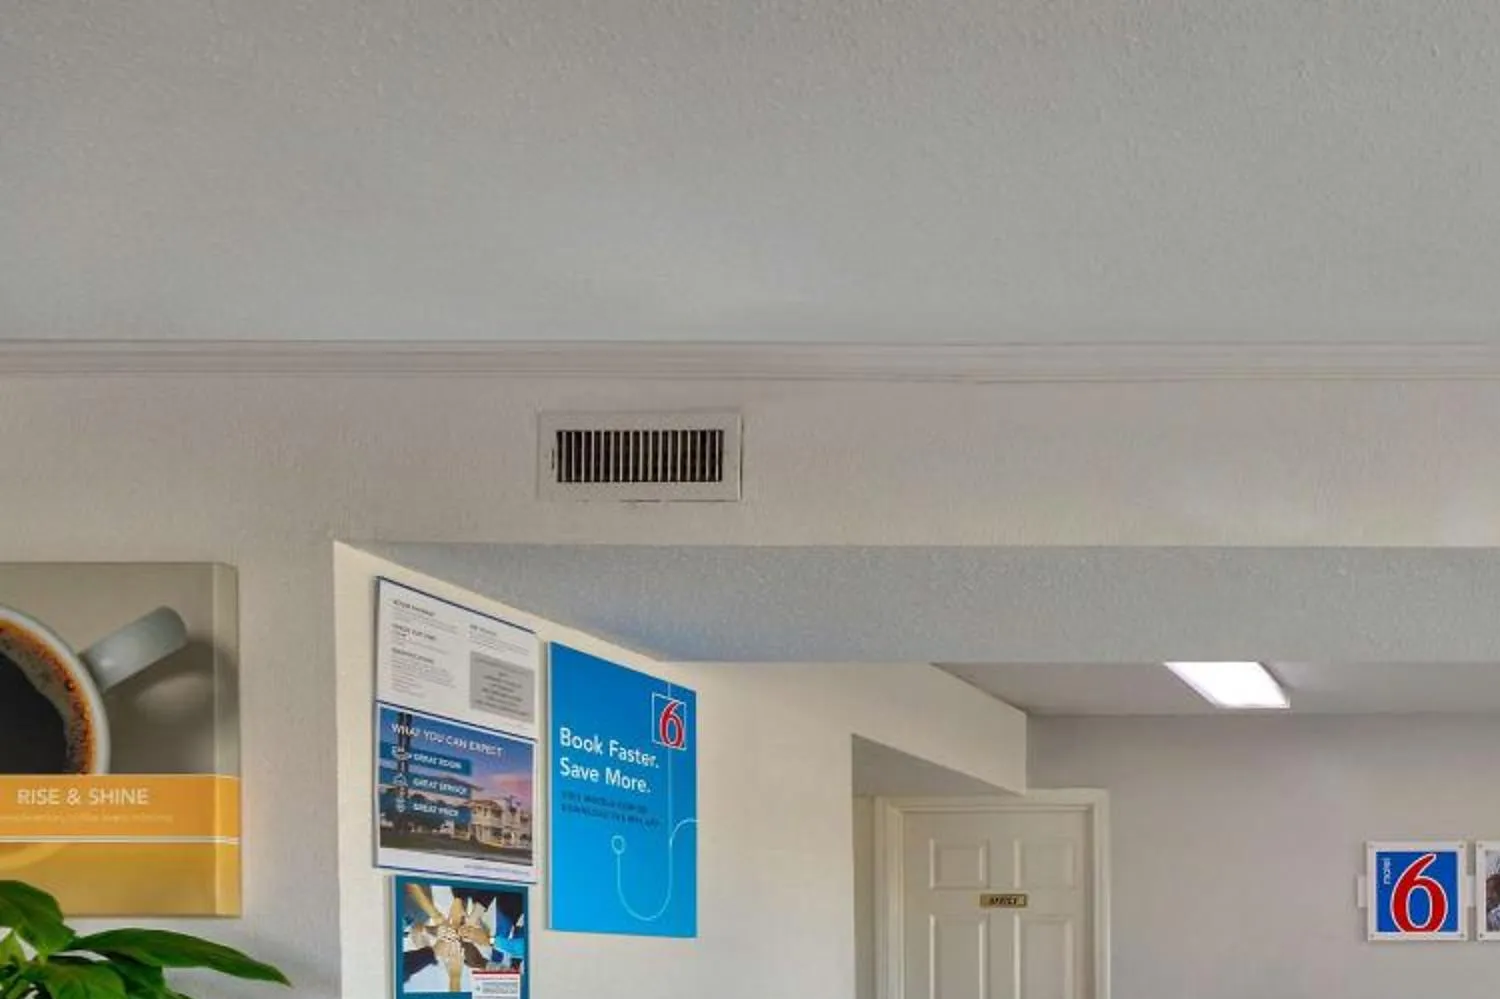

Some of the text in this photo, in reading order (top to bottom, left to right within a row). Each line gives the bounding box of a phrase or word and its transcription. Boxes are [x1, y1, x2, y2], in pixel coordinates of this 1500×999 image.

[660, 699, 684, 748] 6
[423, 729, 445, 743] YOU
[446, 735, 467, 749] CAN
[469, 741, 505, 758] EXPECT
[560, 727, 660, 769] Book Faster.
[560, 757, 652, 794] Save More.
[16, 787, 150, 806] RISE & SHINE
[1390, 853, 1449, 934] 6
